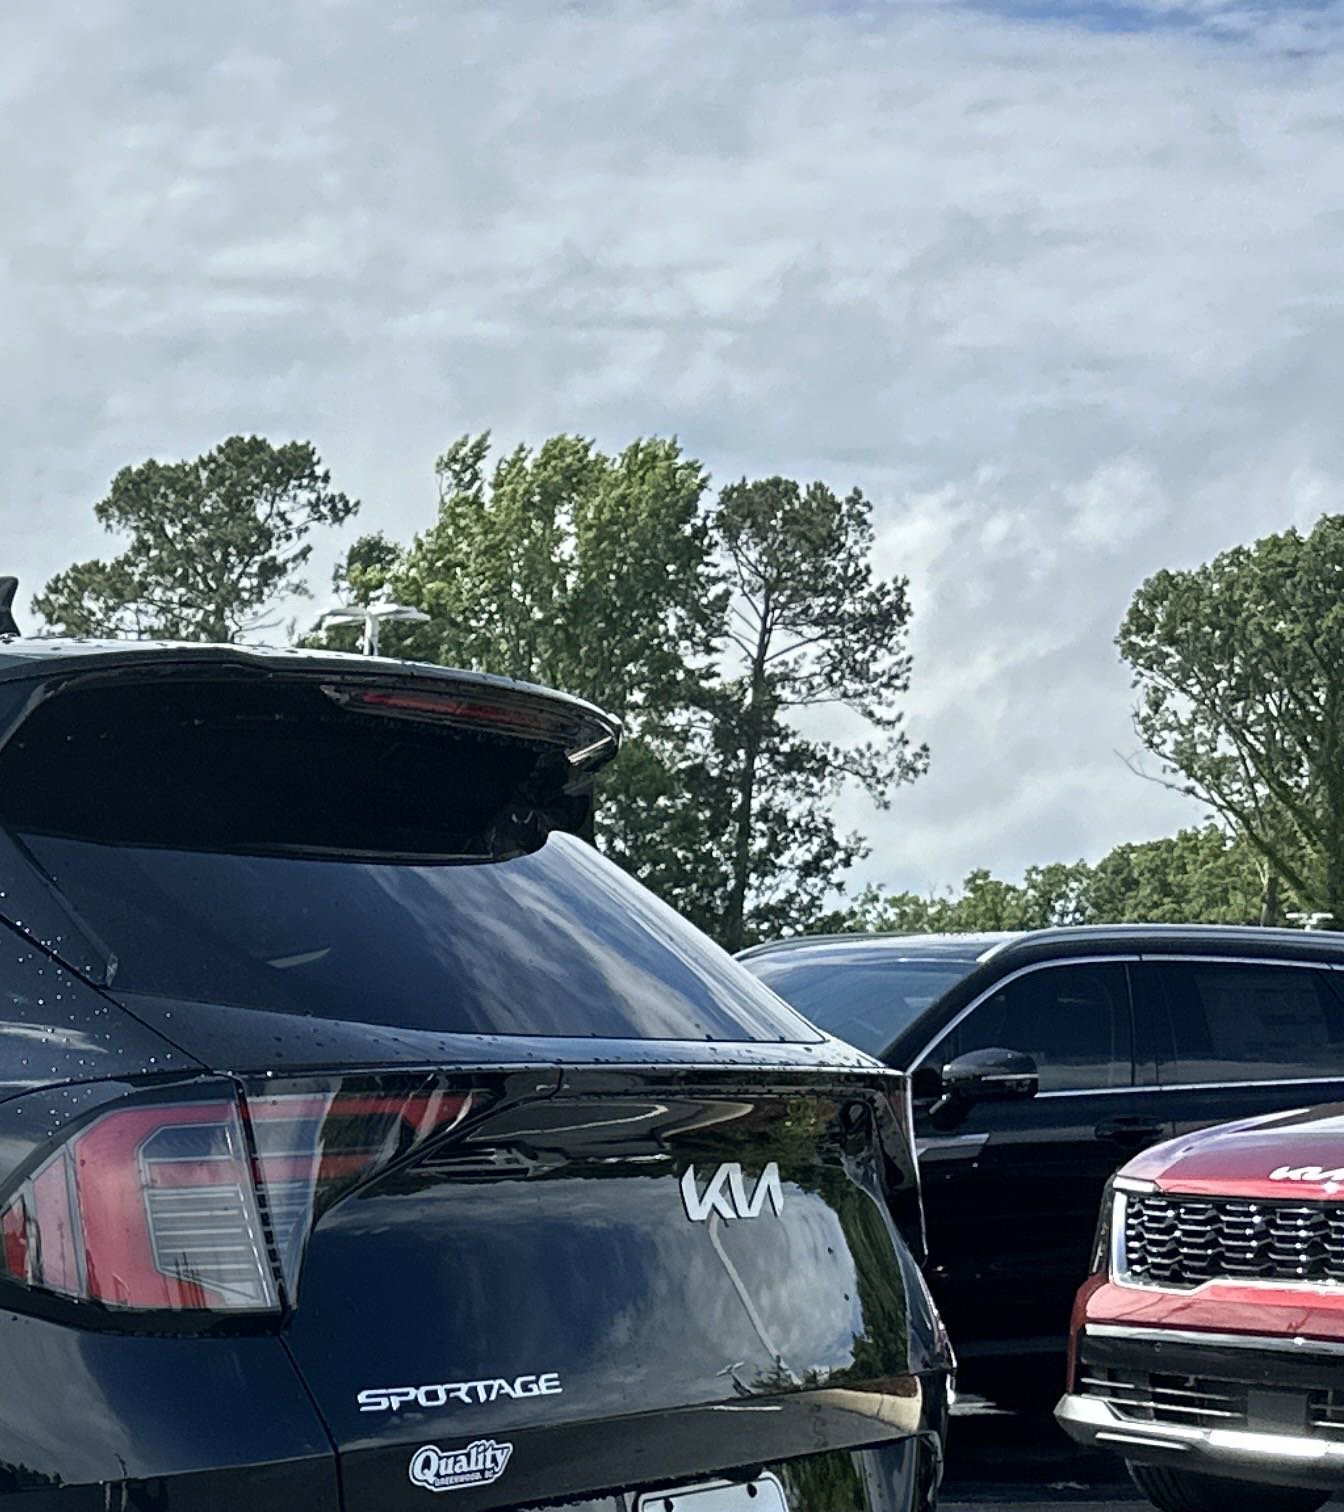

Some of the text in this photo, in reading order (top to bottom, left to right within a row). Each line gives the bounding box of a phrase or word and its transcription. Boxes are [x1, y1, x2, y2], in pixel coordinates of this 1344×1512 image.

[680, 1162, 784, 1221] KIA
[357, 1373, 563, 1412] SPORTAGE
[413, 1446, 510, 1484] Quality
